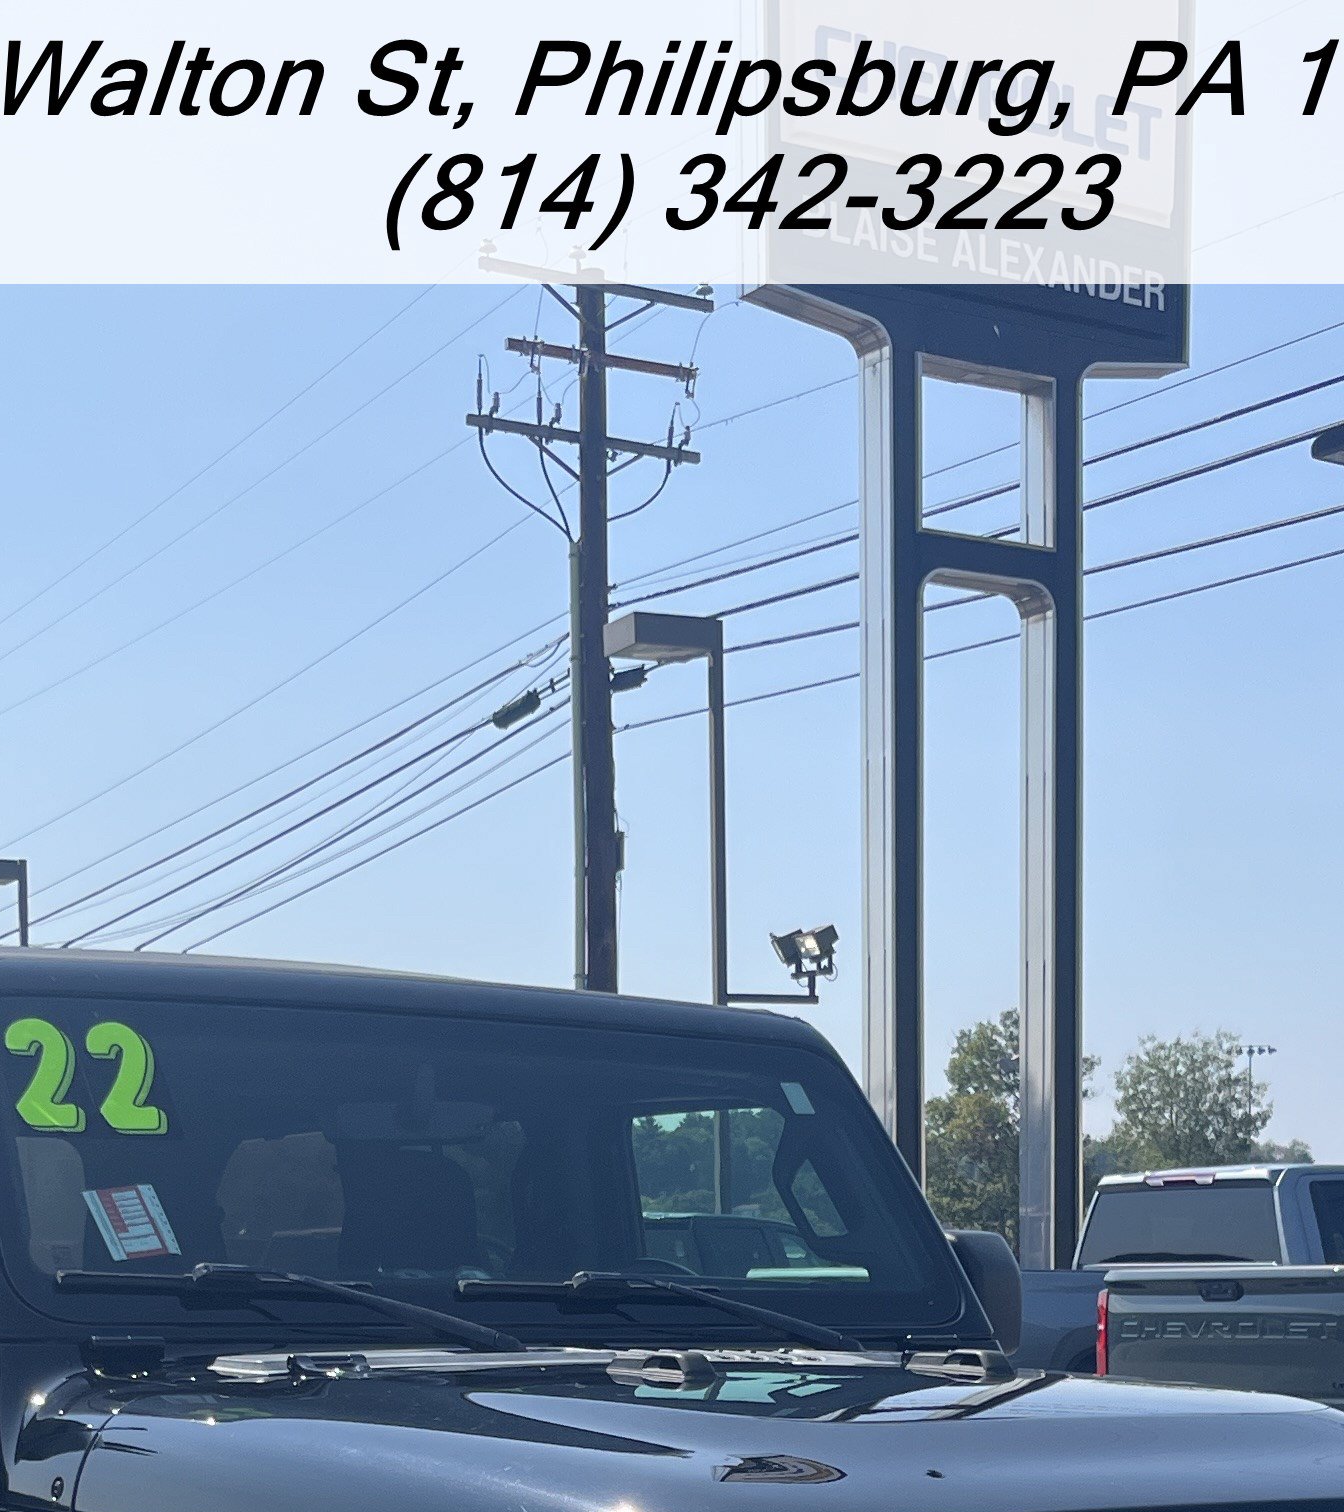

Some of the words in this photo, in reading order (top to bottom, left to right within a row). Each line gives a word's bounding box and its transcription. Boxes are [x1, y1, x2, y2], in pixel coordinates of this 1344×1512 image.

[801, 194, 940, 264] BLAISE
[951, 228, 1167, 312] ALEXANDER
[4, 1016, 169, 1136] 22
[1120, 1321, 1339, 1339] CHEVROLET
